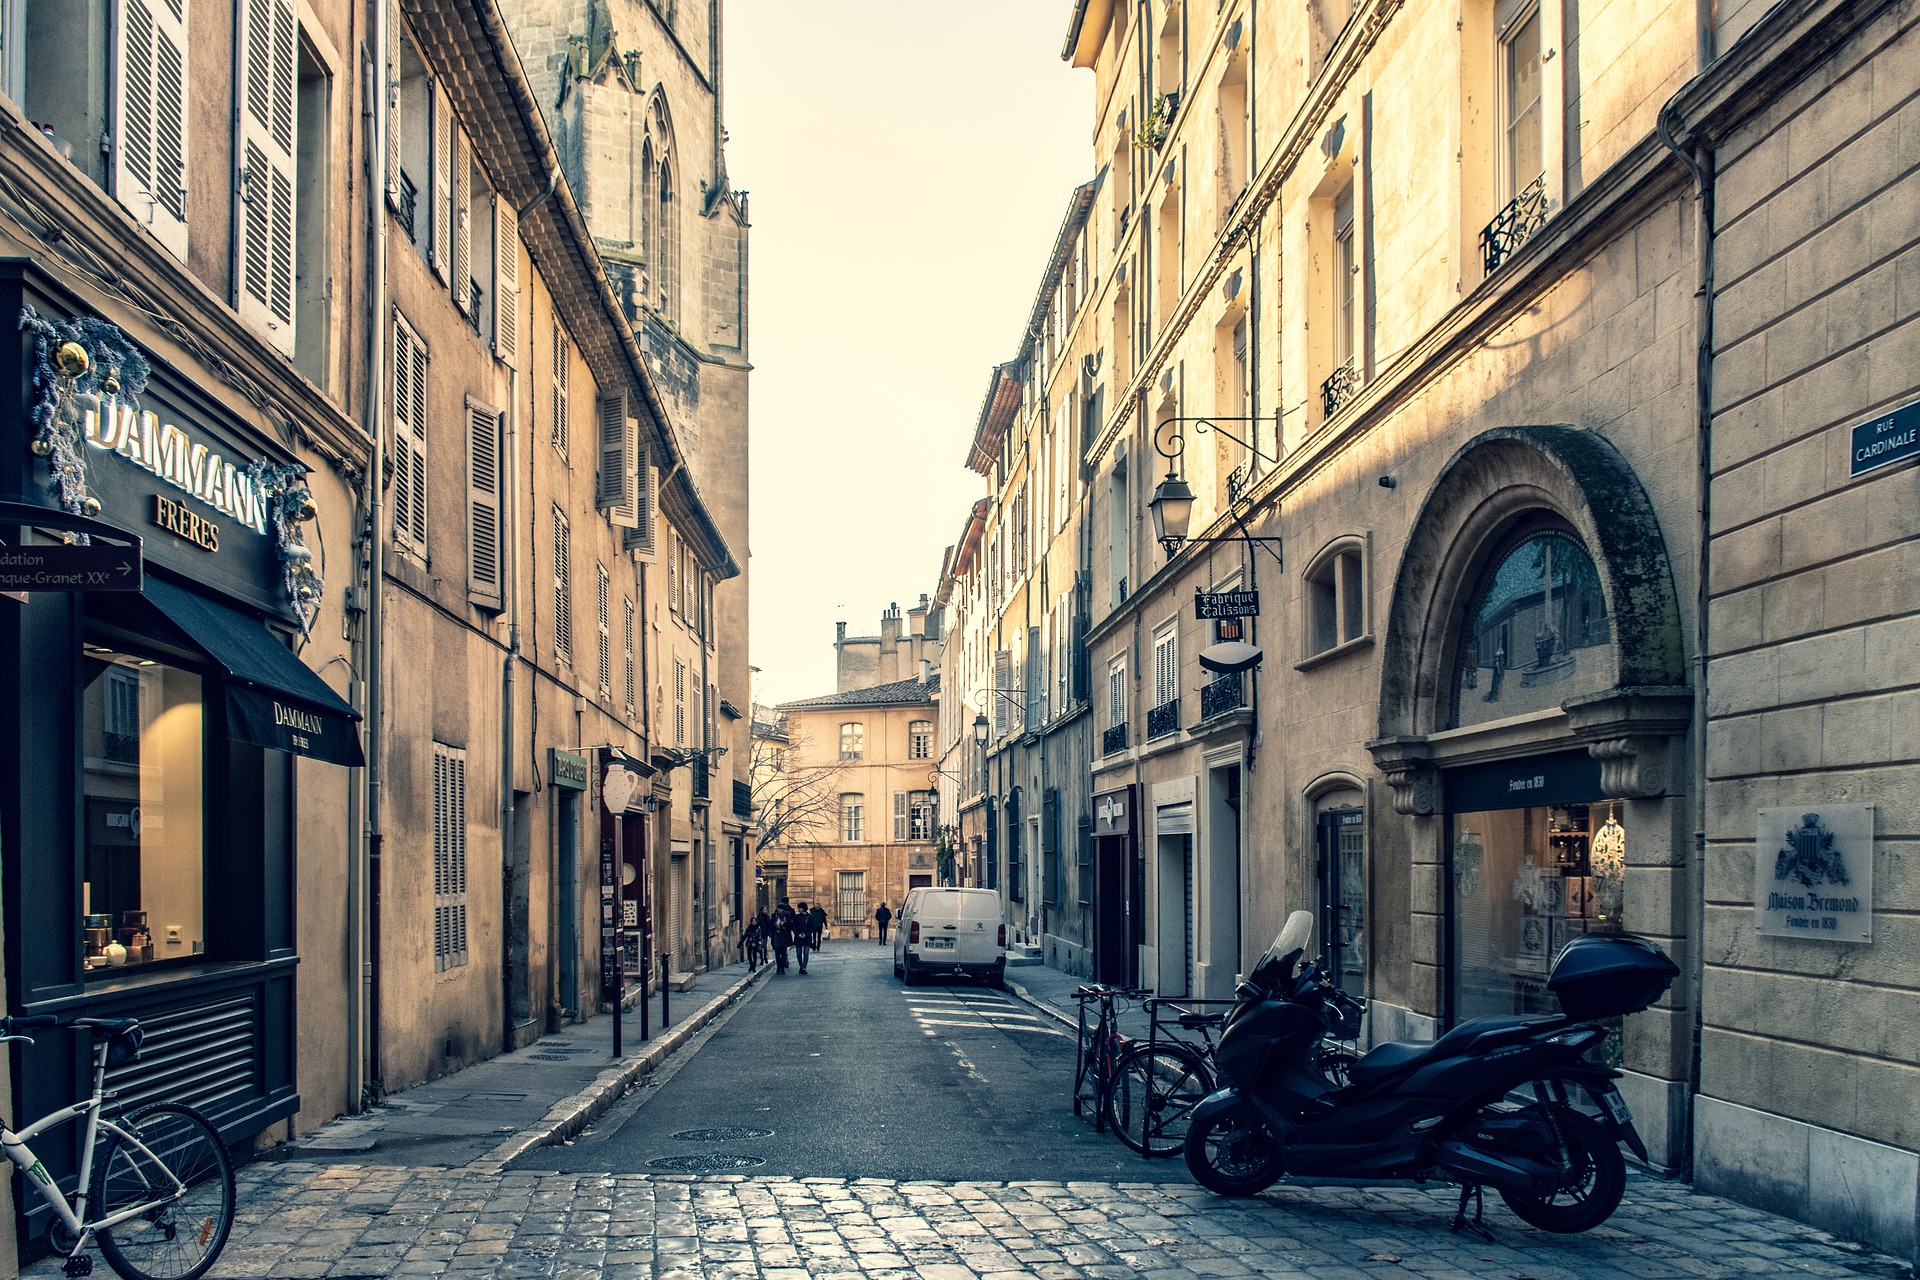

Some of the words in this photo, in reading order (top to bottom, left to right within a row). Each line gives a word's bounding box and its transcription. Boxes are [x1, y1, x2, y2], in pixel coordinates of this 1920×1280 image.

[1877, 418, 1895, 434] RUE
[1856, 428, 1917, 462] CARDINALE
[155, 494, 219, 553] FRÈRES
[0, 552, 44, 566] dation
[1201, 593, 1254, 606] Fabrique
[273, 701, 322, 735] DAMMANN
[1766, 892, 1805, 911] Maison
